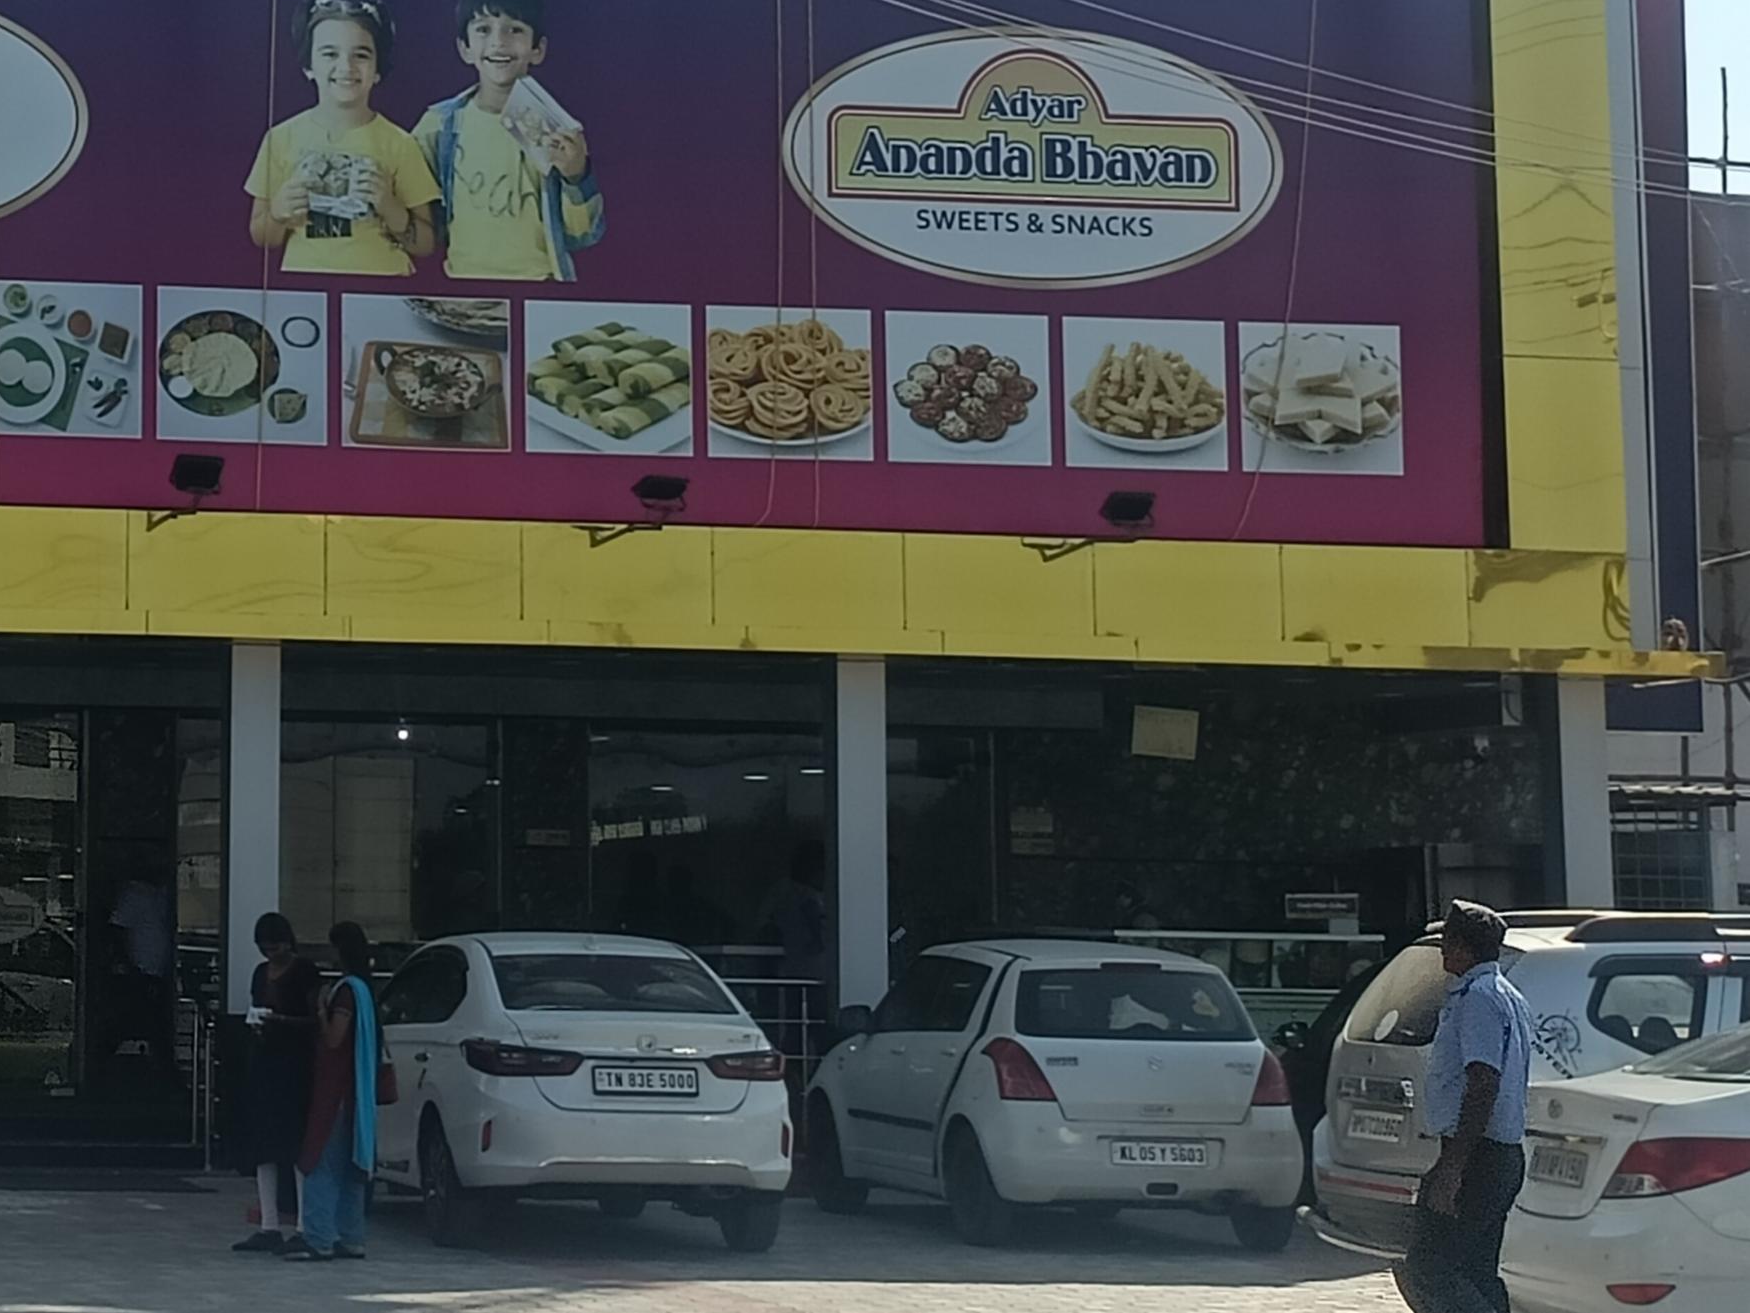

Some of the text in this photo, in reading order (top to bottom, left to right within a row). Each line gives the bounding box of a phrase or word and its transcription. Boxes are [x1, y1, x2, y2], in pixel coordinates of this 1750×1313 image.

[982, 86, 1086, 126] Adyar
[852, 128, 1217, 188] Ananda Bhavan
[916, 209, 1154, 237] SWEETS & SNACKS
[606, 1072, 623, 1087] TN
[659, 1073, 694, 1089] 5000
[1120, 1146, 1137, 1161] KL
